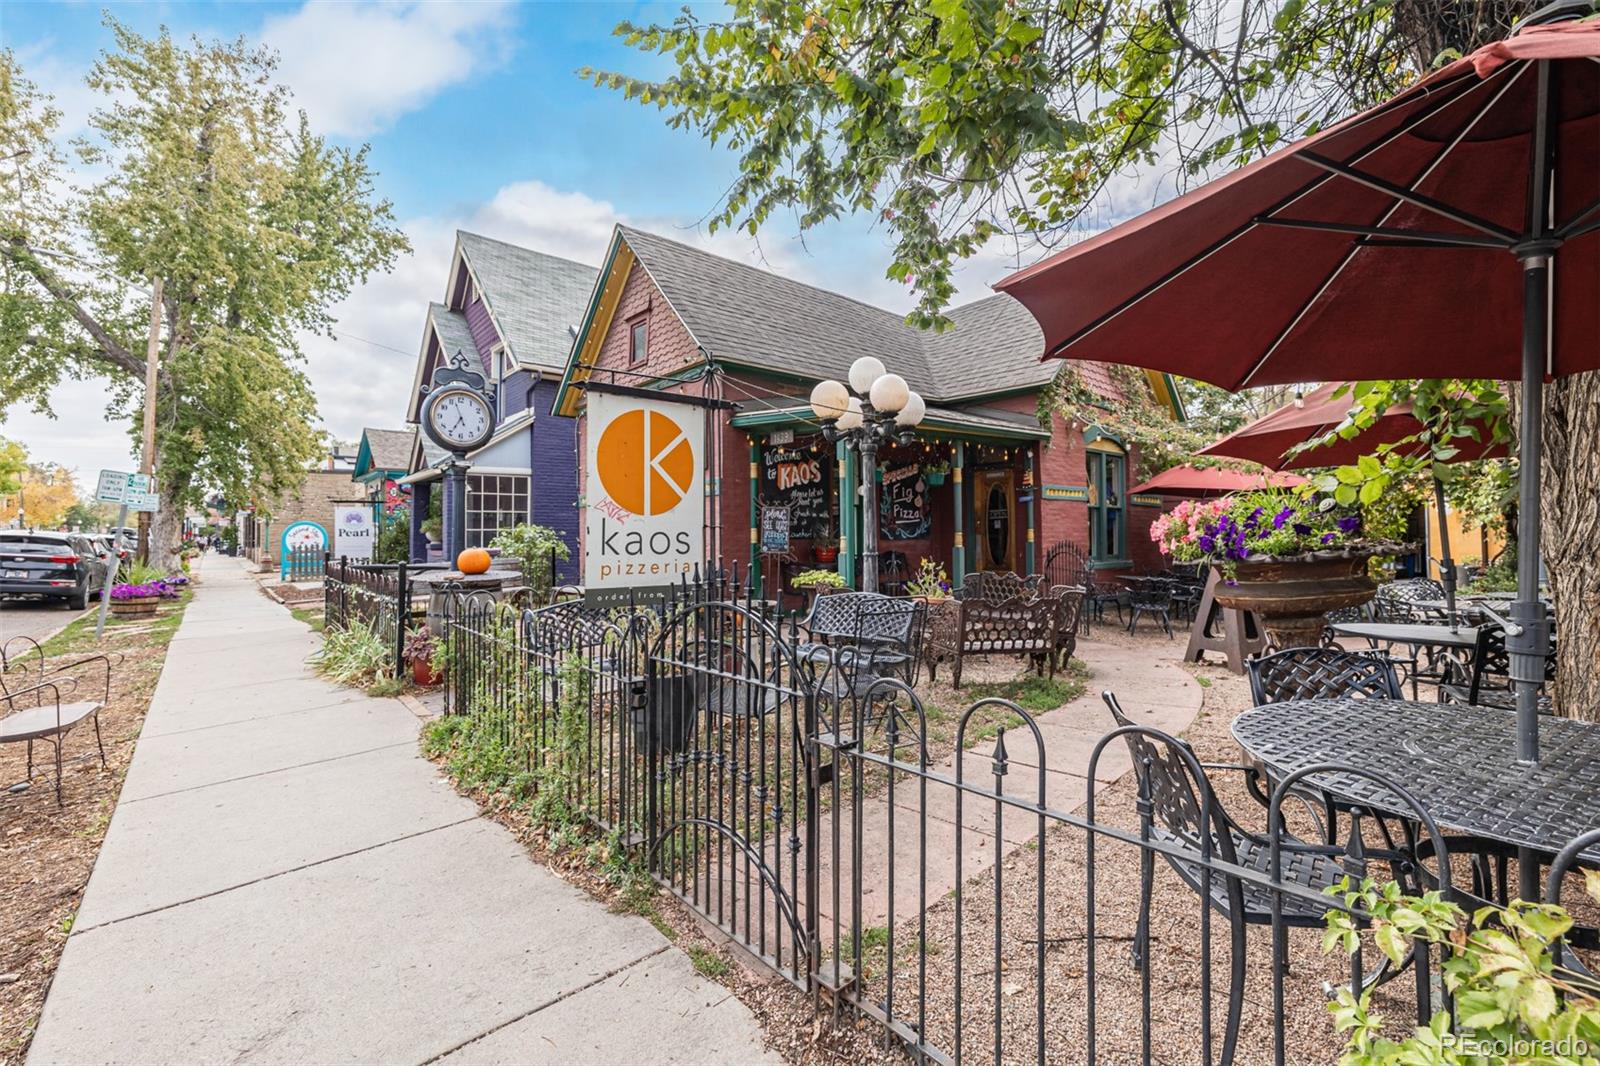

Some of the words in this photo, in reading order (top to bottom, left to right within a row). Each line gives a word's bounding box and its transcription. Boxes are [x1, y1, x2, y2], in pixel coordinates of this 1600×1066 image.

[767, 468, 777, 480] to
[777, 460, 822, 490] KAOS
[893, 483, 913, 503] Fig
[893, 504, 920, 519] Pizza
[338, 528, 370, 537] Pearl
[601, 518, 691, 556] kaos
[601, 559, 691, 580] pizzeria
[597, 590, 631, 601] order
[638, 591, 665, 599] from
